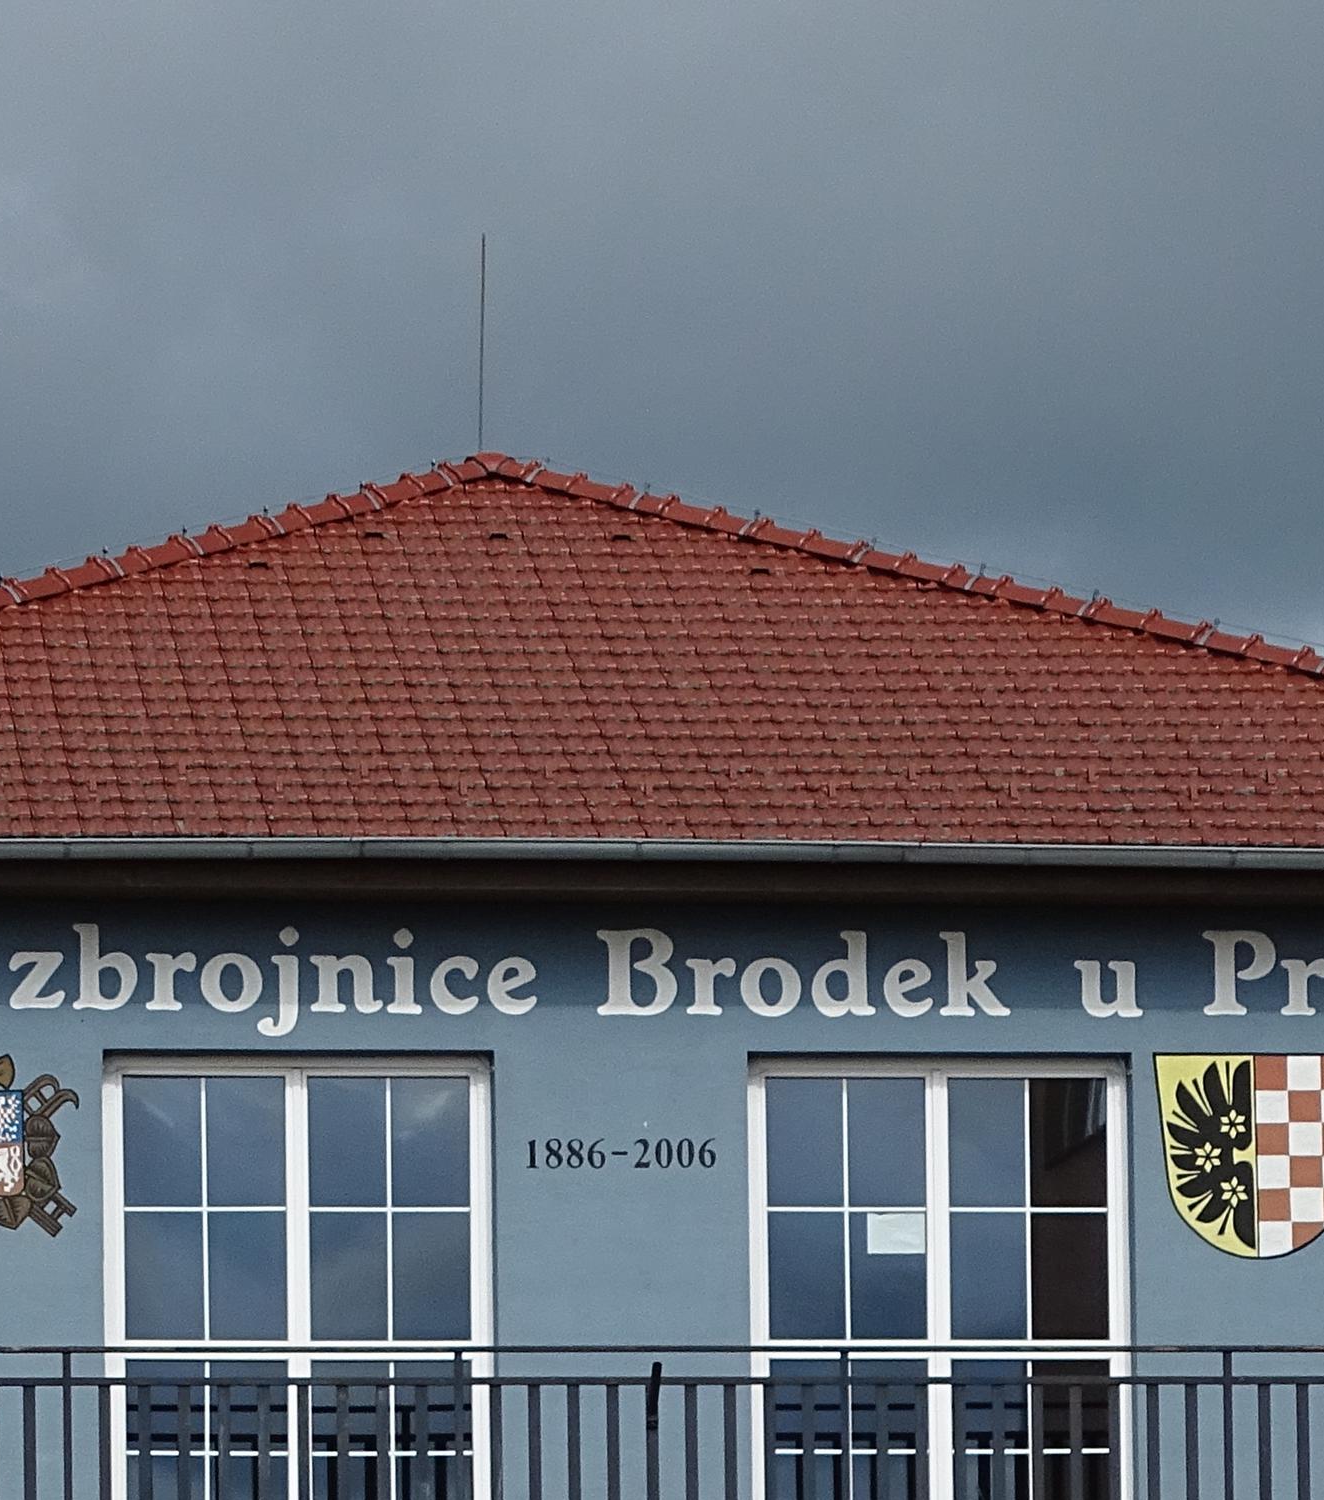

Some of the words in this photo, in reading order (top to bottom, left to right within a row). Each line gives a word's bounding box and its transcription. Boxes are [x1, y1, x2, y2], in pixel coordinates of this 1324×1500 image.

[8, 923, 537, 1037] zbrojnice
[596, 927, 1011, 1017] Brodek
[1074, 959, 1143, 1017] u
[525, 1137, 717, 1170] 1886-2006
